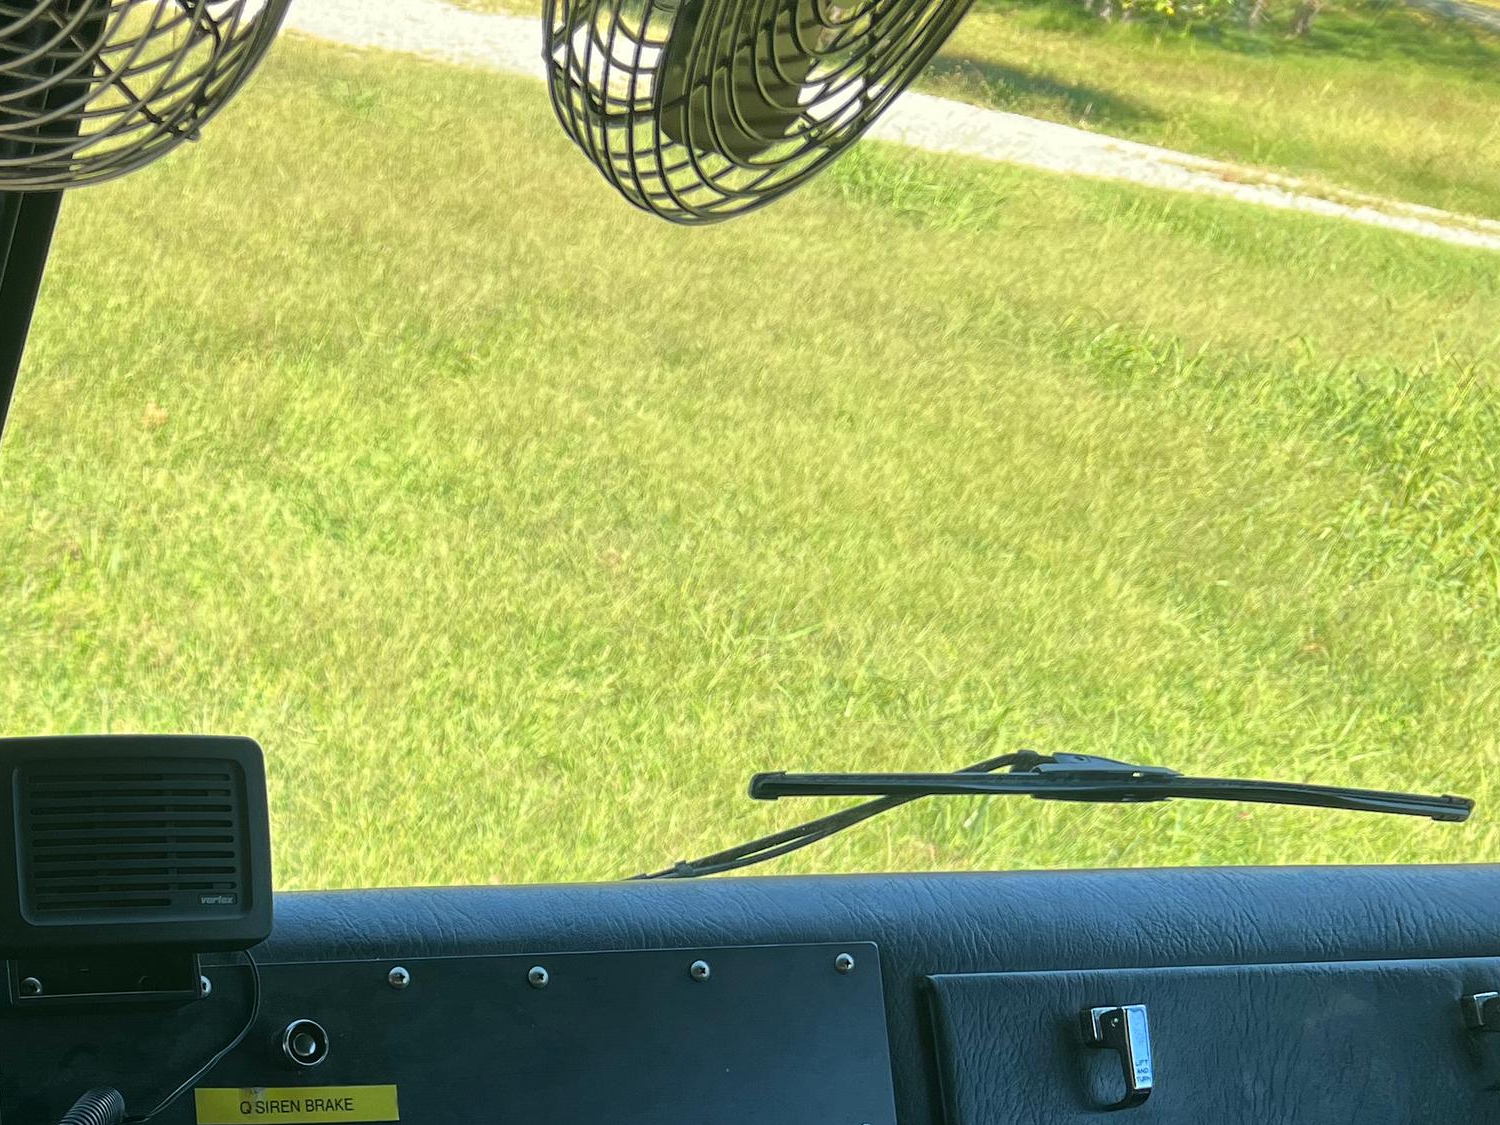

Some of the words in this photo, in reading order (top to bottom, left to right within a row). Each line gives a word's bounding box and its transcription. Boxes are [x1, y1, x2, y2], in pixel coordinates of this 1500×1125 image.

[239, 1101, 252, 1114] Q
[254, 1099, 301, 1114] SIREN
[304, 1097, 354, 1113] BRAKE
